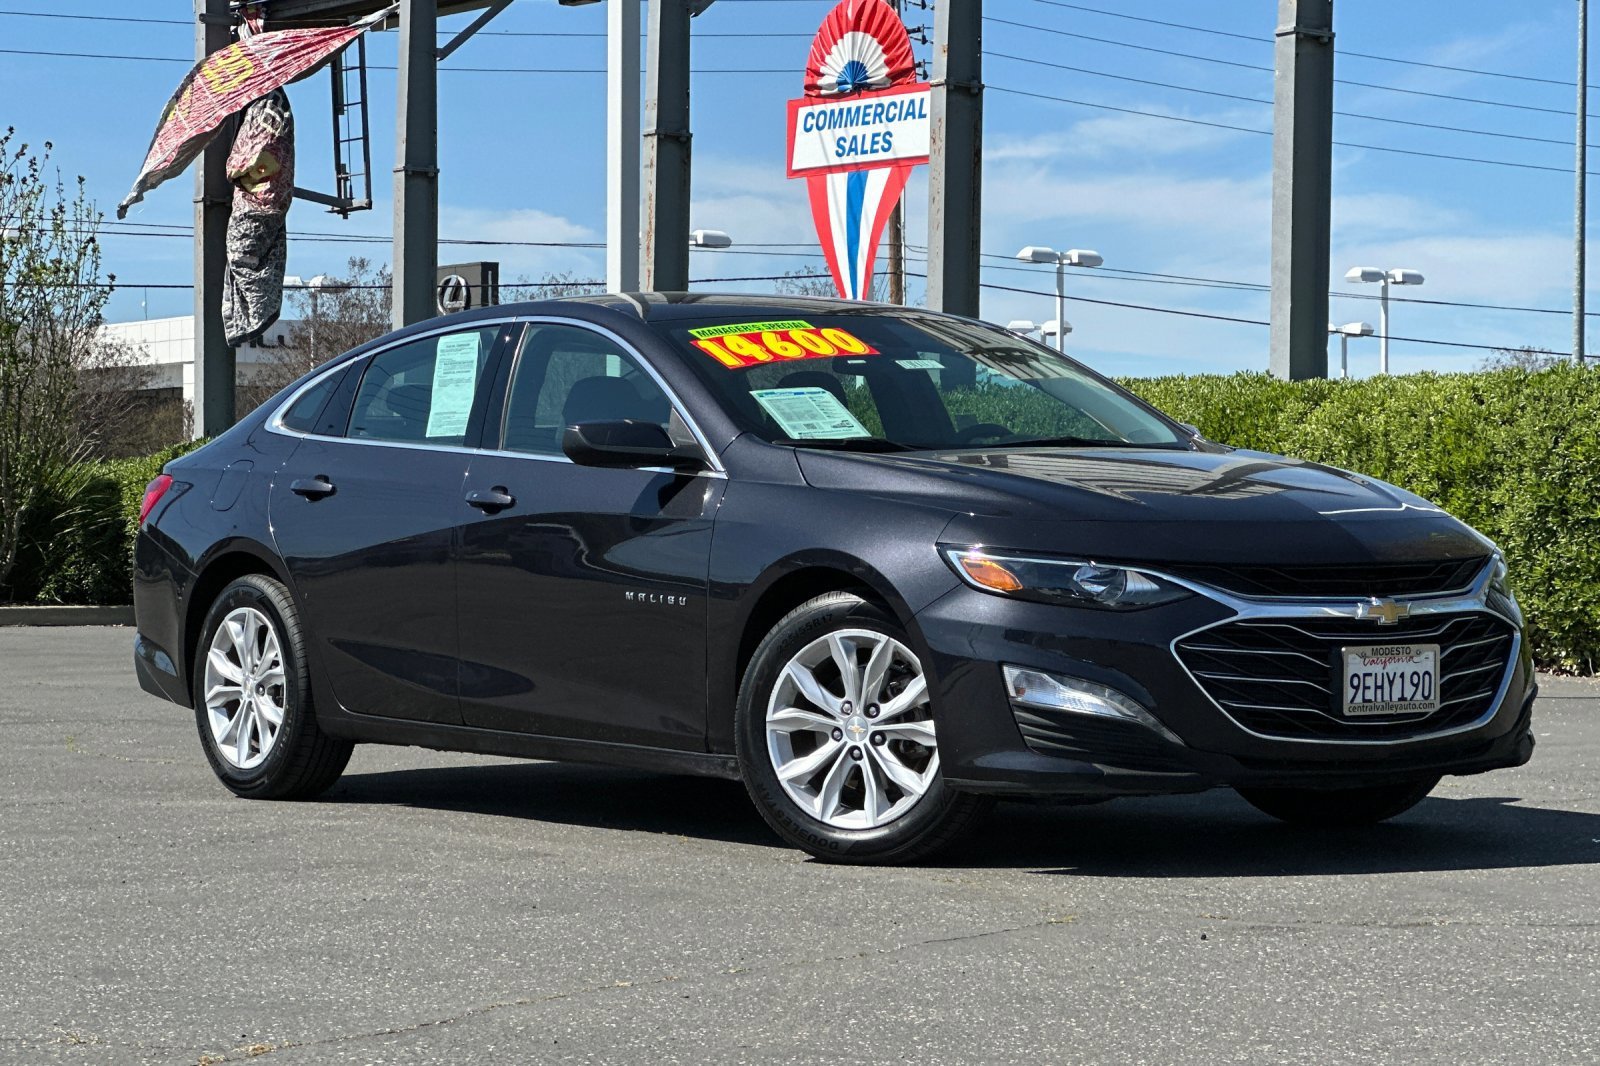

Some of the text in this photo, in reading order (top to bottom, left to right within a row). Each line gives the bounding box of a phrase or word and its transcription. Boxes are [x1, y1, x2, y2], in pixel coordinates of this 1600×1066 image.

[803, 97, 927, 132] COMMERCIAL
[835, 131, 893, 157] SALES
[696, 321, 807, 337] MANAGER'S SPECIAL
[697, 328, 869, 367] 14600
[625, 591, 687, 606] MALIBU
[1371, 646, 1411, 656] MODESTO
[1349, 670, 1432, 704] 9EHY190
[1348, 702, 1435, 713] centralvalleyauto.com
